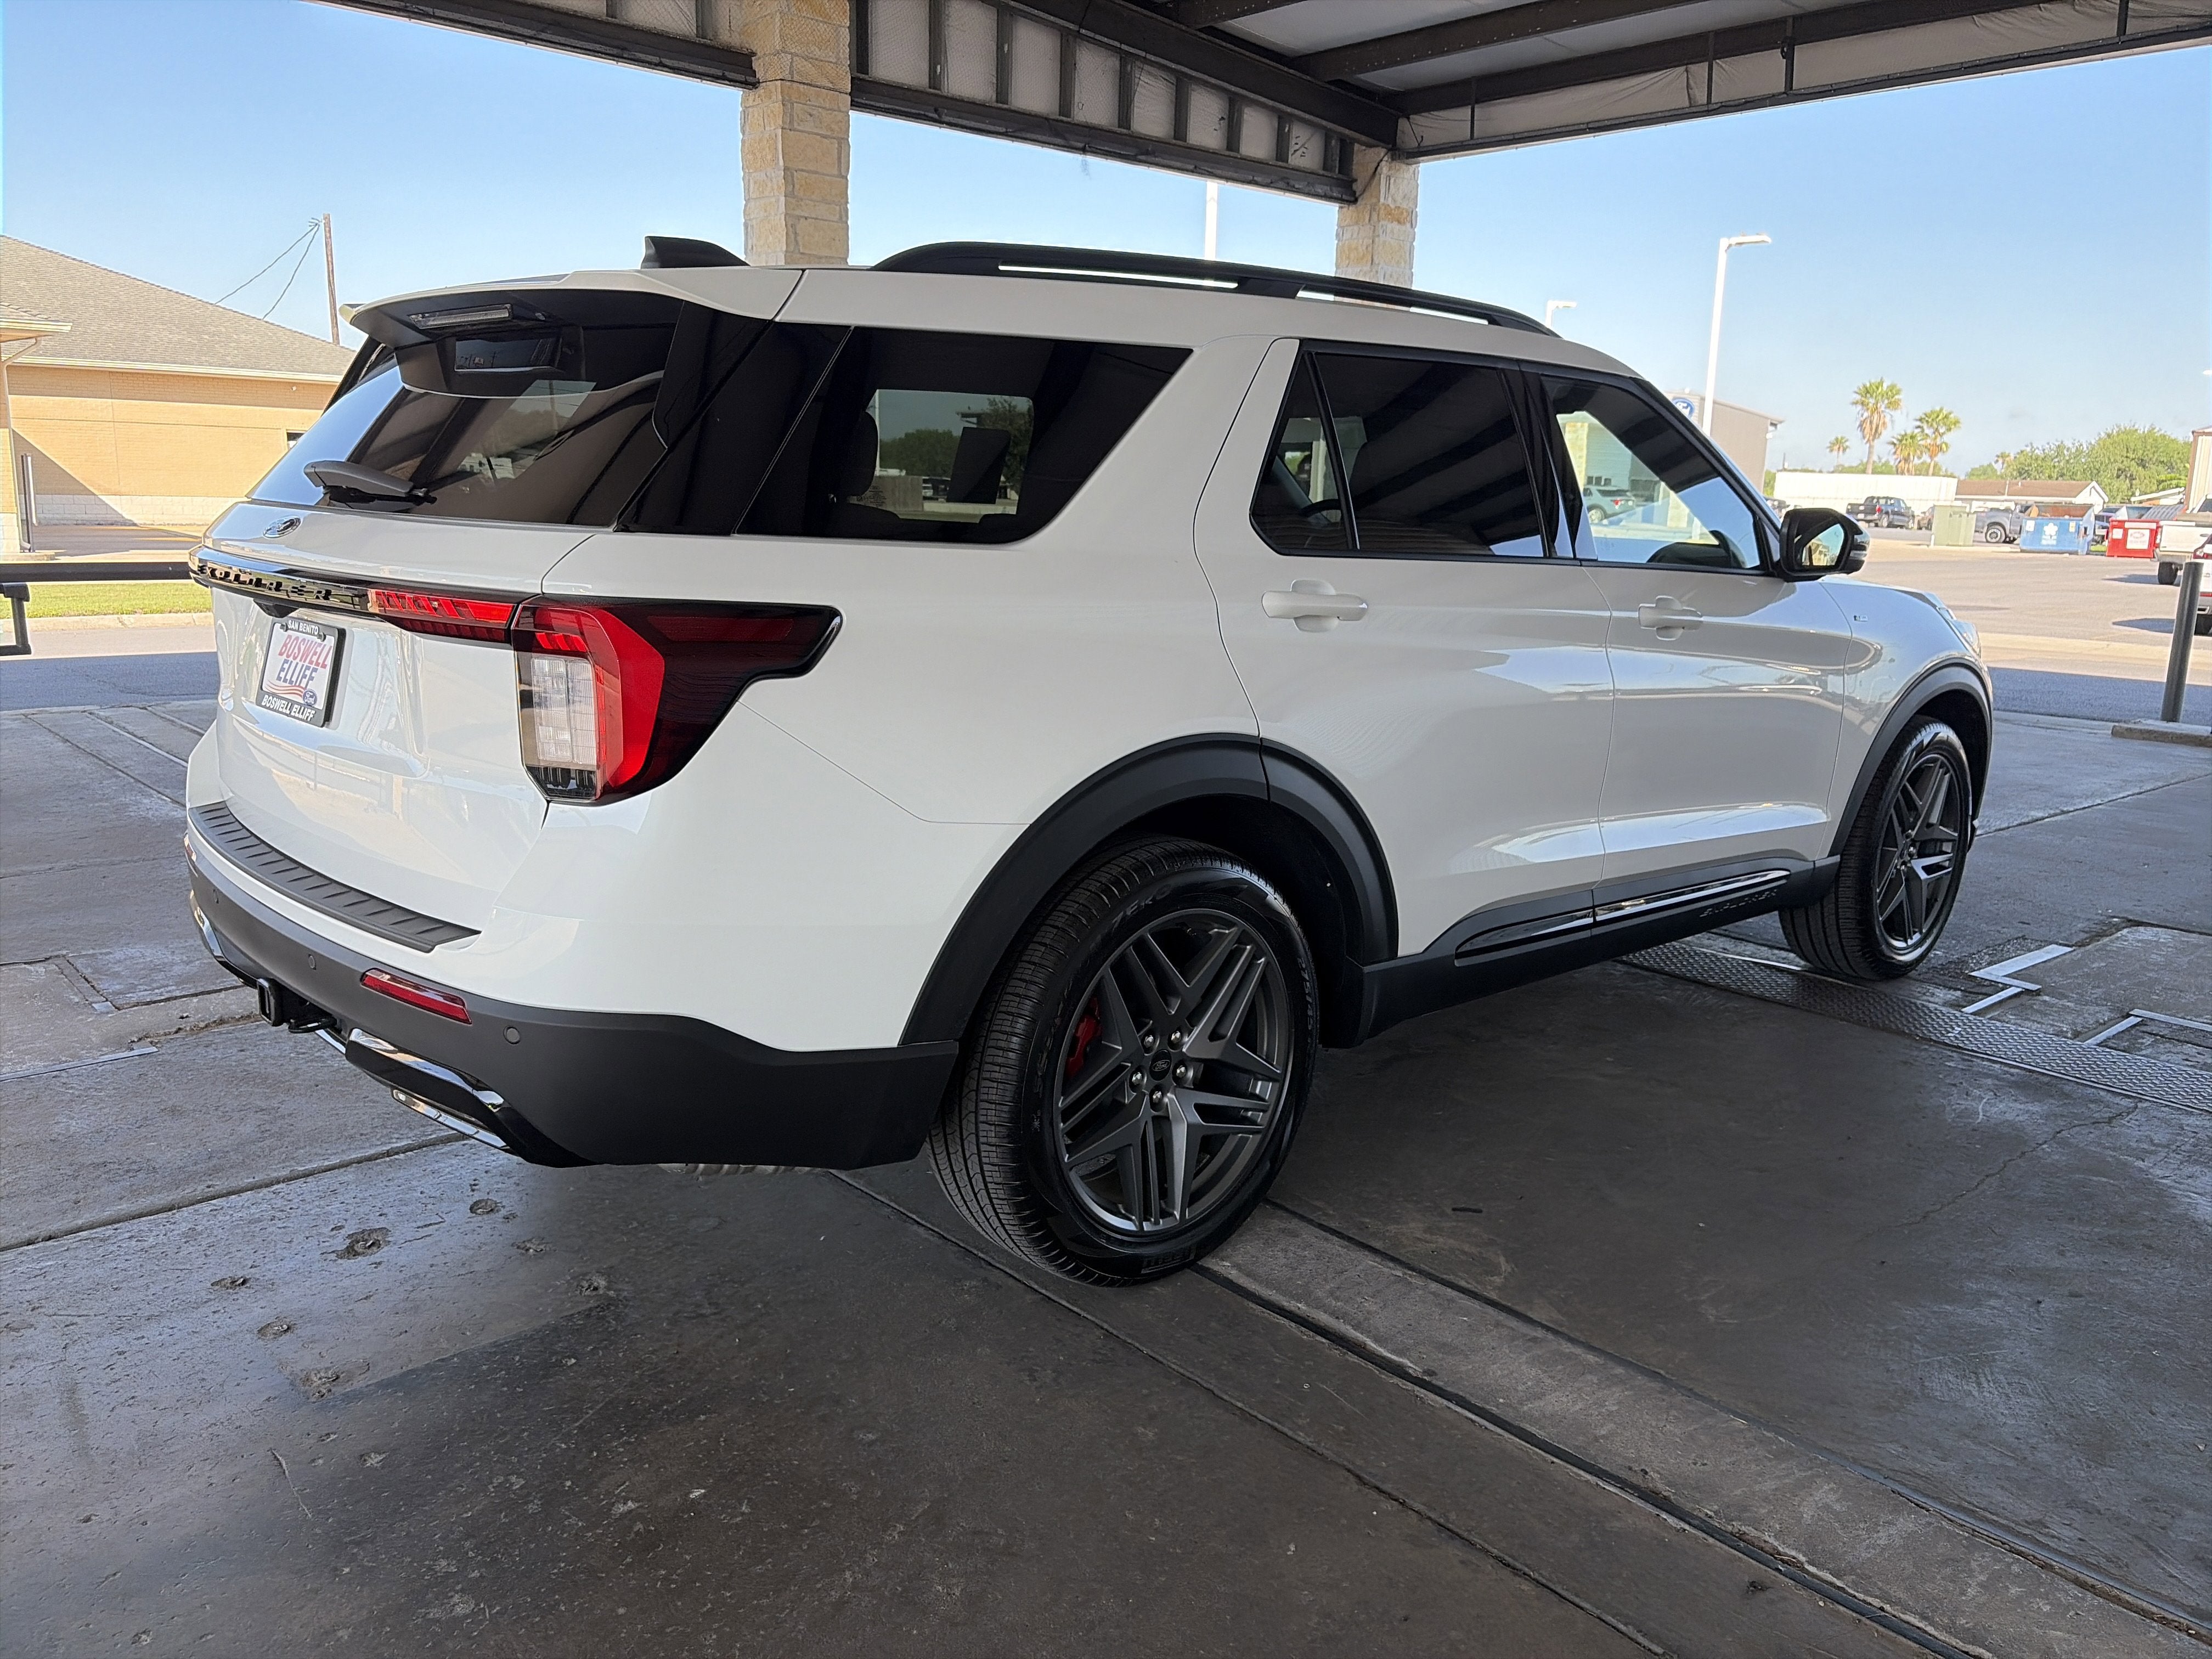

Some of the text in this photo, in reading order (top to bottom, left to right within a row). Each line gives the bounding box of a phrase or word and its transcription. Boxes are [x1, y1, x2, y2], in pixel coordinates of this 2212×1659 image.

[288, 620, 319, 635] SAN BENITO
[278, 634, 333, 669] BOSWELL
[276, 658, 319, 690] ELLIFF
[261, 695, 316, 722] BOSWELL ELLIFF
[303, 691, 317, 705] Ford
[1154, 1061, 1169, 1070] Ford
